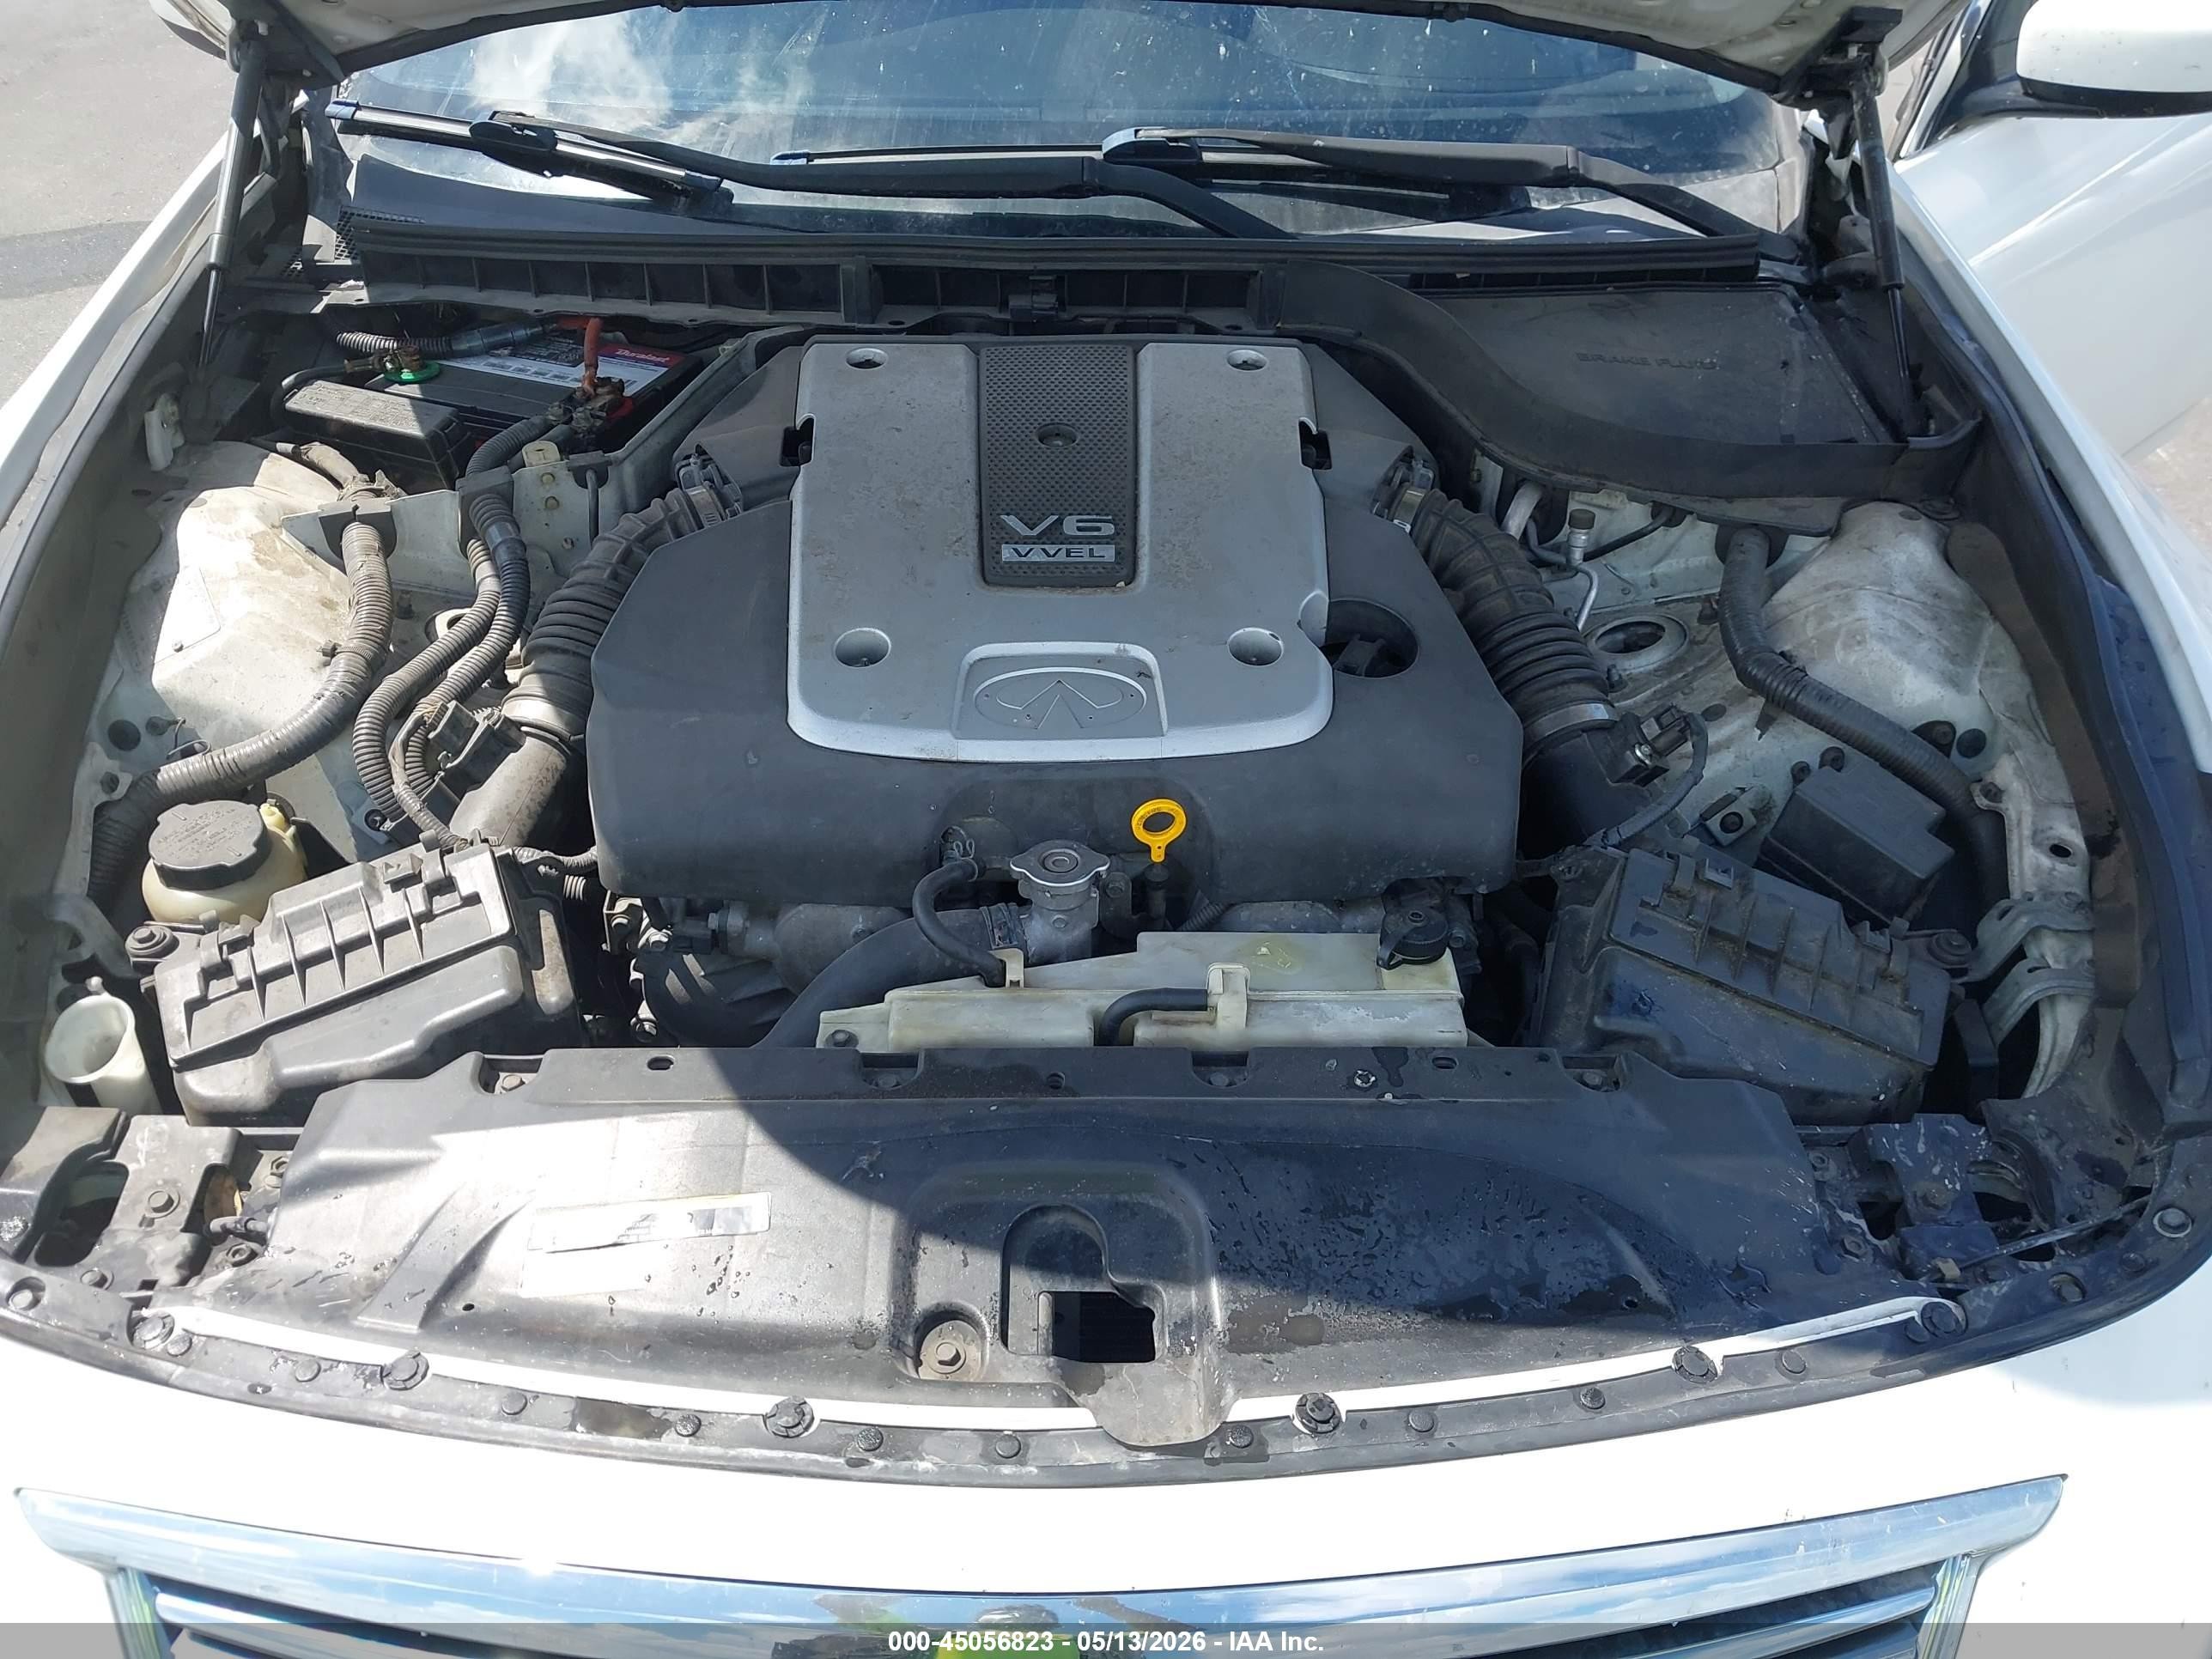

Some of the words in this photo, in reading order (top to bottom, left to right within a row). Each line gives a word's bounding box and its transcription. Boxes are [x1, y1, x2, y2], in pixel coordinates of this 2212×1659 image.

[616, 349, 670, 362] Duralast
[1575, 352, 1651, 366] BRAKE
[1000, 514, 1115, 536] V6
[1011, 547, 1106, 558] VVEL
